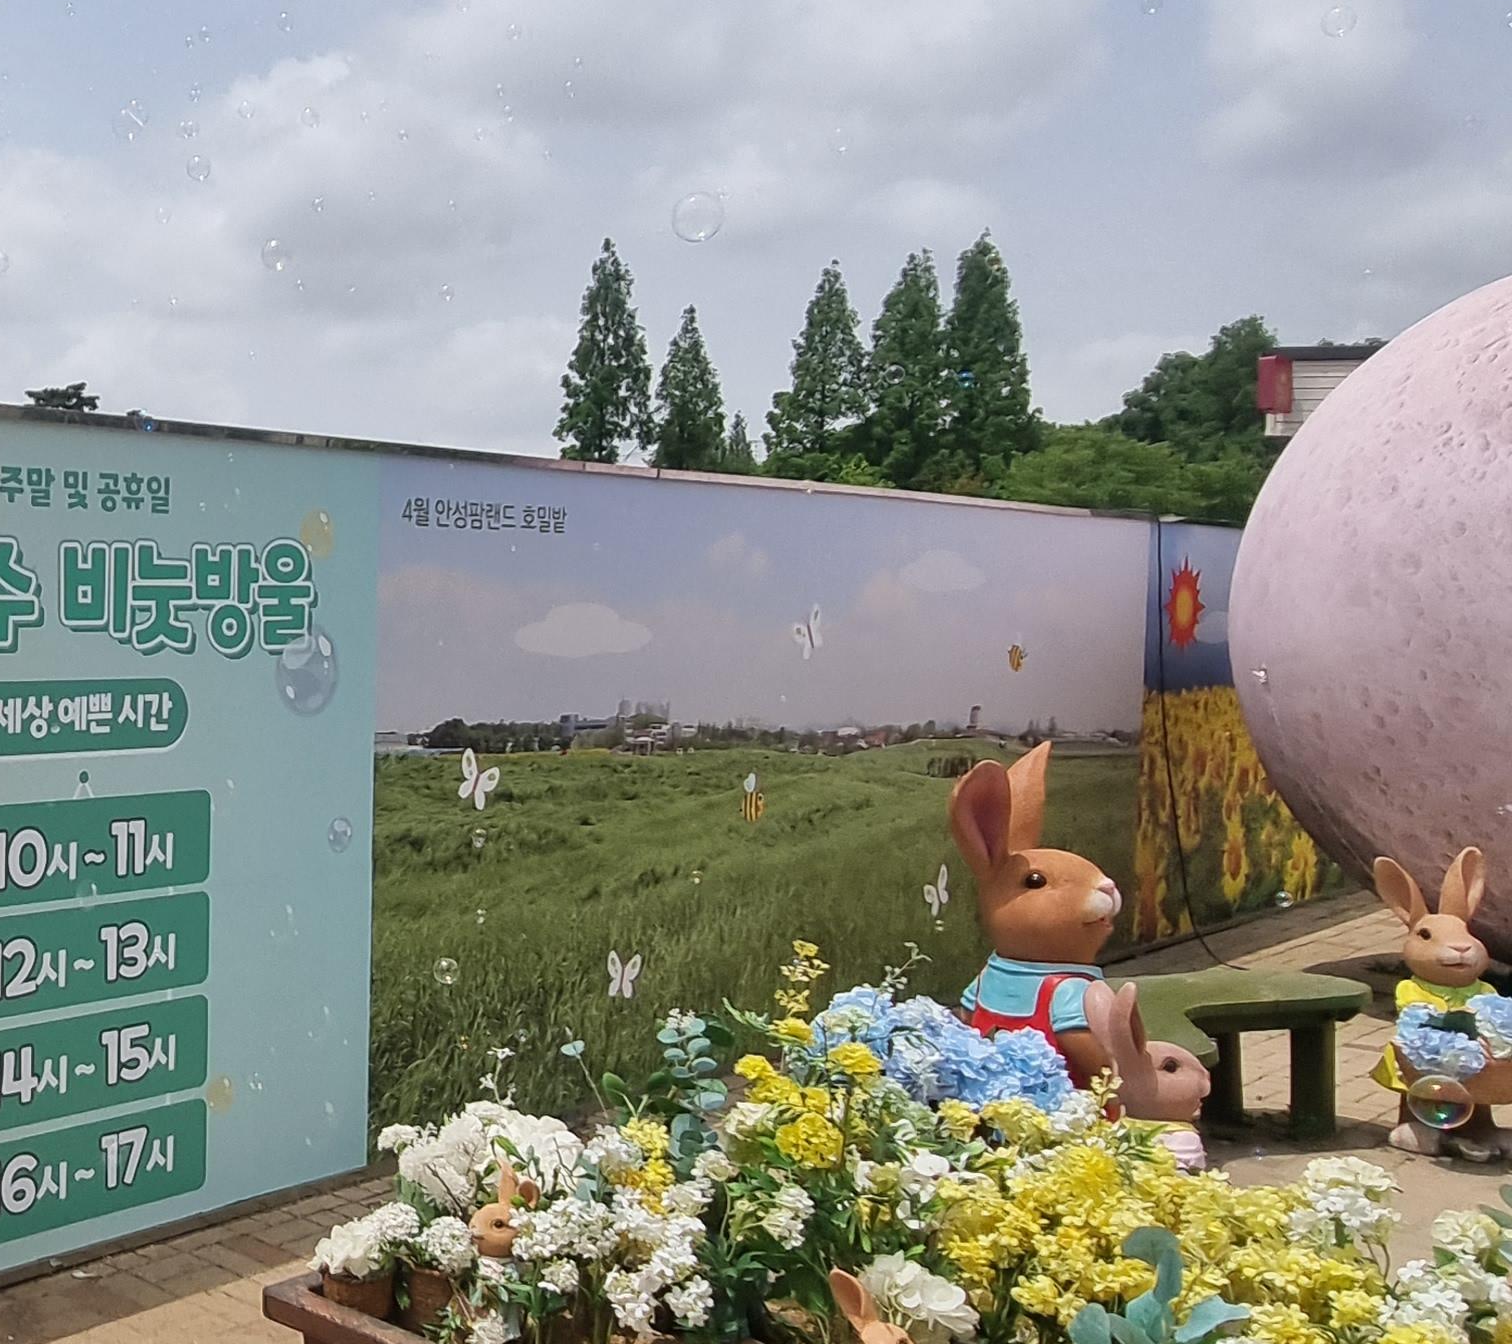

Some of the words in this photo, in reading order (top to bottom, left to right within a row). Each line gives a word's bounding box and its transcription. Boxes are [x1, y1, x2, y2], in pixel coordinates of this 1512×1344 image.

[0, 465, 55, 507] 주말
[63, 470, 88, 509] 및
[97, 472, 170, 514] 공휴일
[401, 497, 430, 527] 4월
[435, 499, 516, 530] 안성팜랜드
[520, 506, 567, 534] 호밀밭
[58, 538, 318, 659] 비눗방울
[57, 692, 113, 734] 예쁜
[117, 692, 173, 732] 시간
